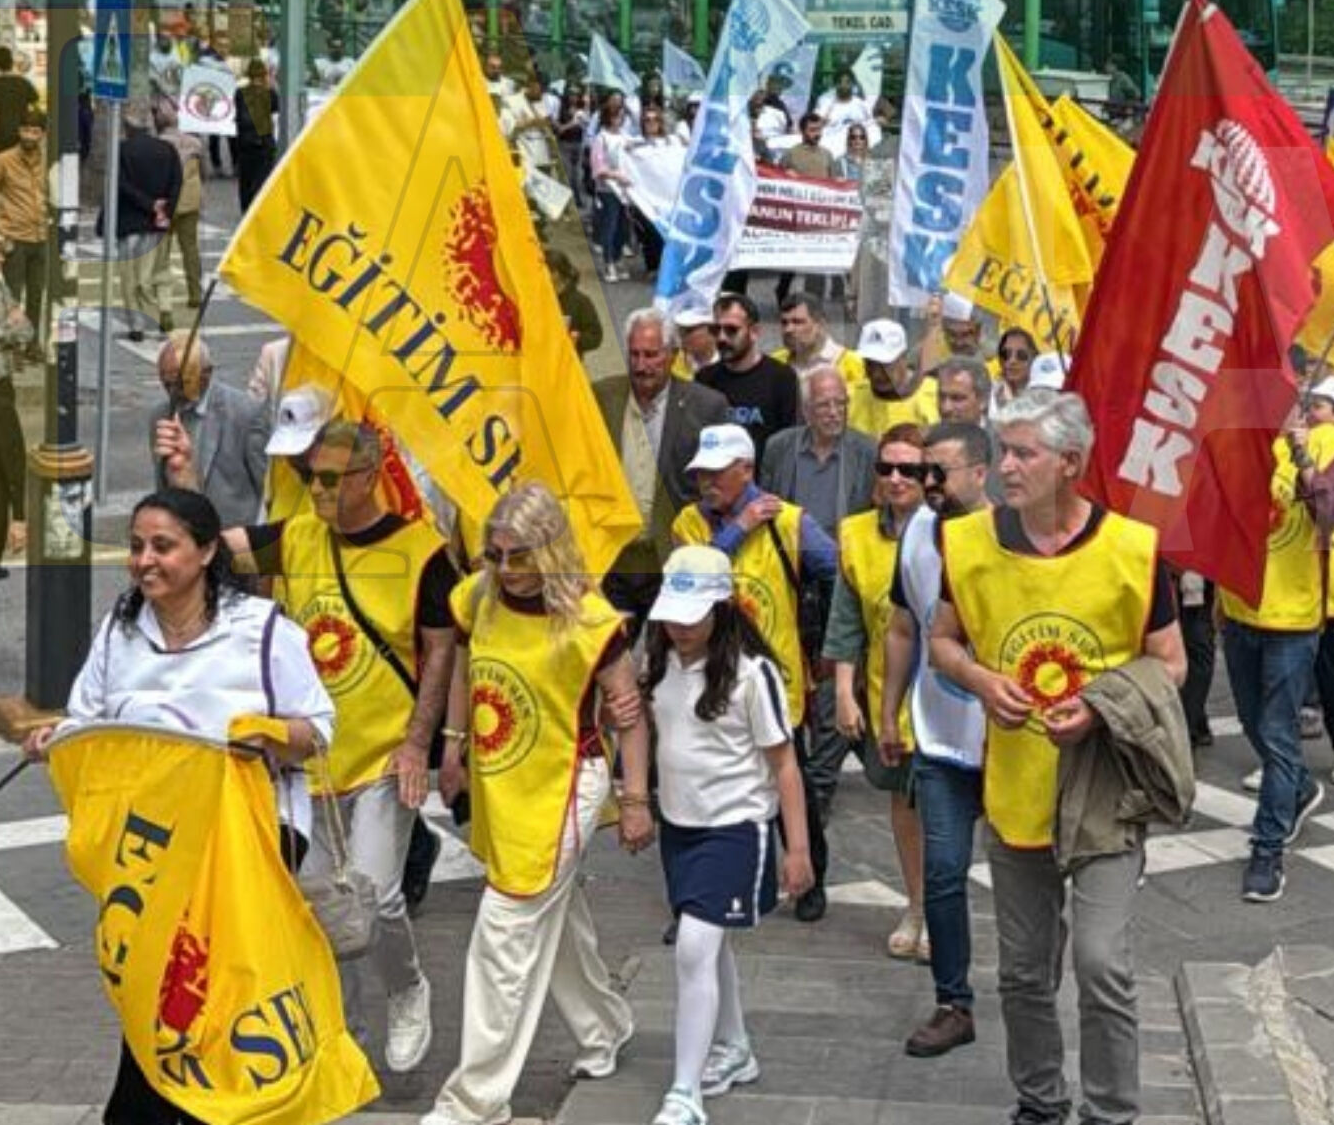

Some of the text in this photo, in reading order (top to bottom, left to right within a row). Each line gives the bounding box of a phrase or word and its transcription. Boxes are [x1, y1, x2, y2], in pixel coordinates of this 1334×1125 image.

[831, 15, 896, 31] TEKEL CAD.
[903, 43, 978, 293] KESK
[278, 207, 484, 422] EĞİTİM
[1117, 221, 1253, 498] KESK
